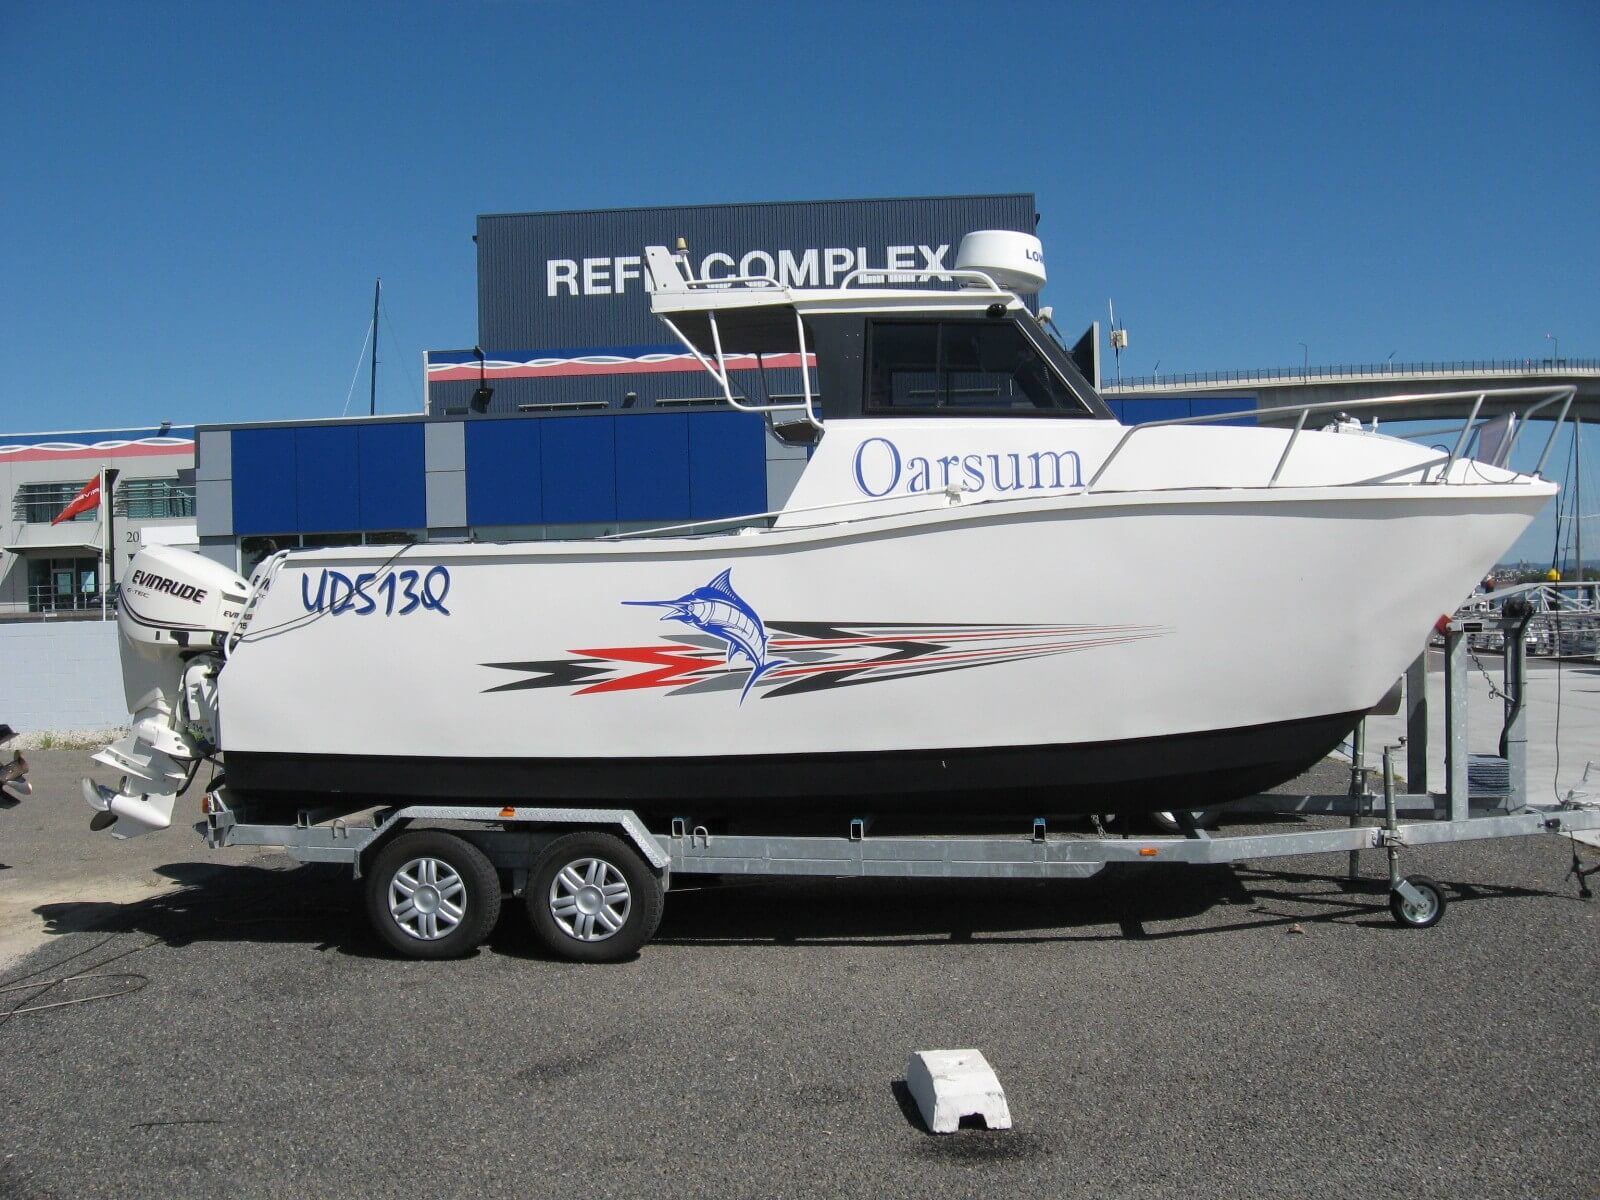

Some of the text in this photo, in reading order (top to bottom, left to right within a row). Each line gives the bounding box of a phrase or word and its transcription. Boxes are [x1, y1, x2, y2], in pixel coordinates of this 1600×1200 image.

[700, 244, 953, 289] COMPLEX
[852, 437, 1086, 497] Oarsum
[126, 531, 139, 543] 20
[132, 569, 207, 604] EVINRUDE
